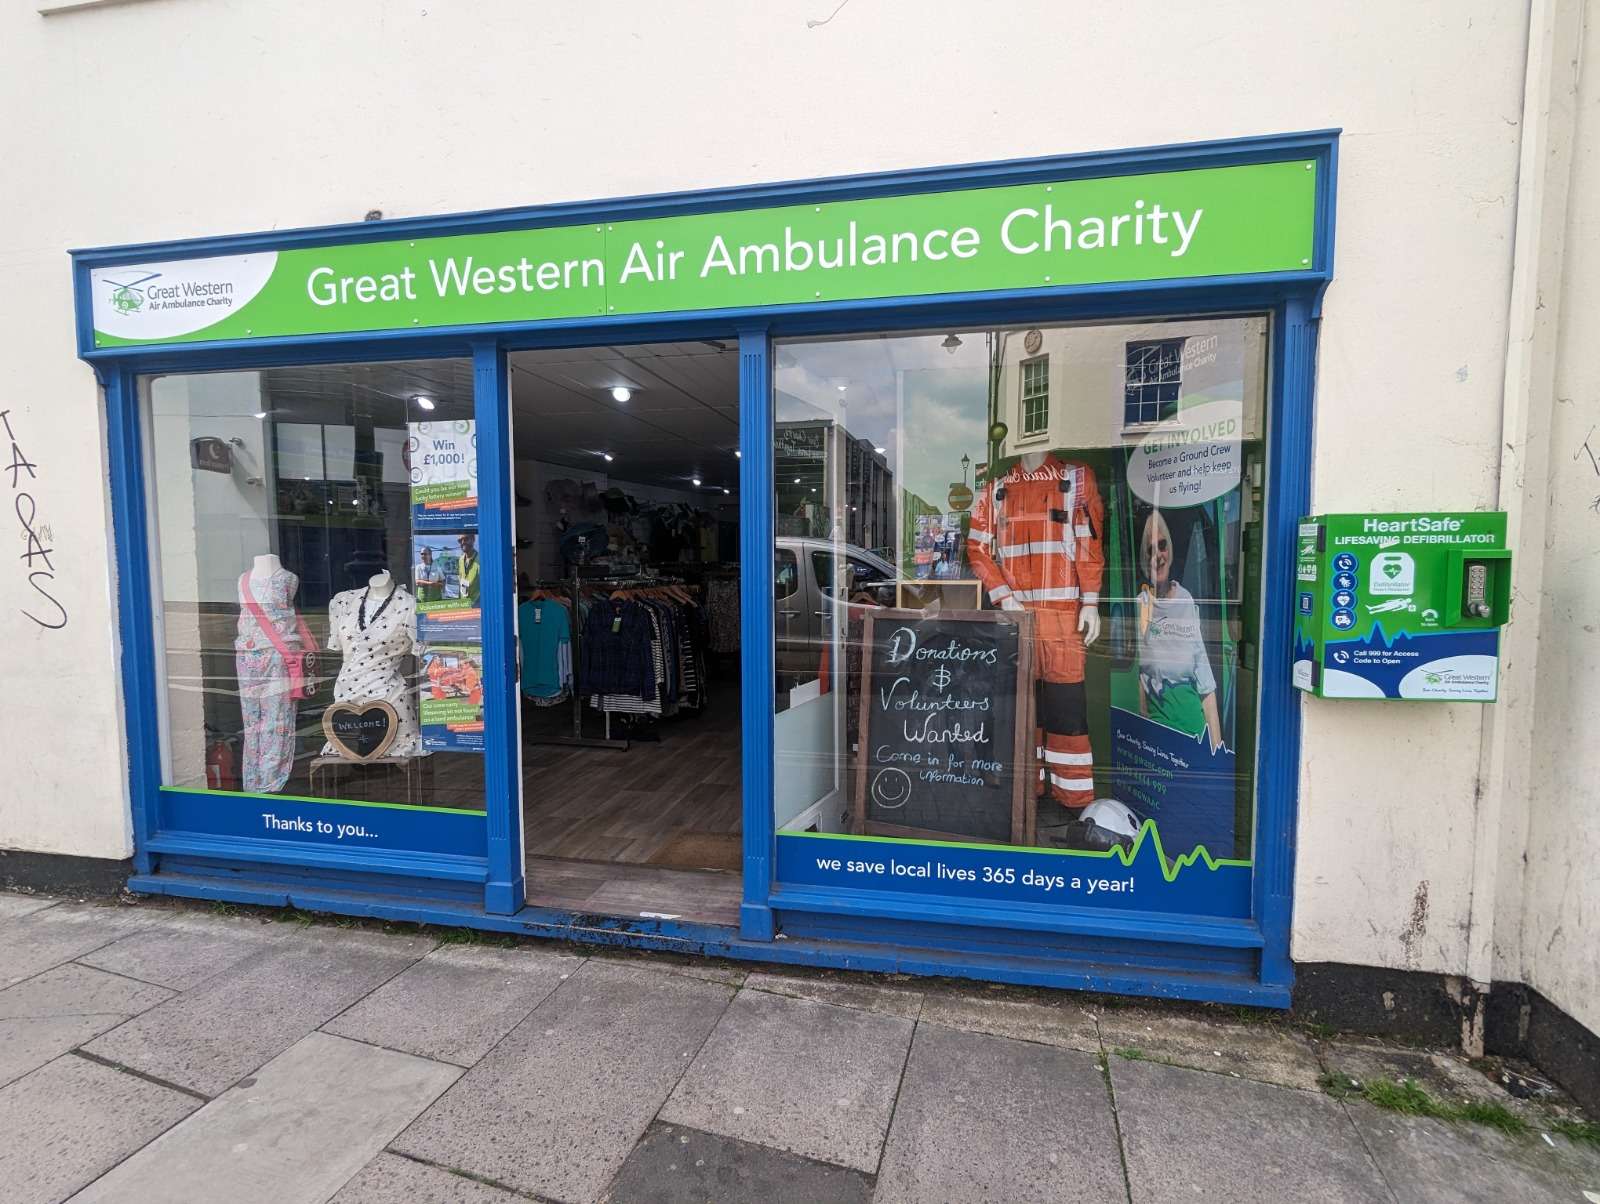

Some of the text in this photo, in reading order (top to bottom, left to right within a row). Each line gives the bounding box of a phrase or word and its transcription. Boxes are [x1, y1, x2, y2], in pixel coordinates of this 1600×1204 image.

[307, 199, 1203, 305] Great Western Air Ambulance Charity
[147, 280, 233, 300] Great Western
[149, 296, 233, 311] Air Ambulance Charity
[432, 439, 455, 451] Win
[1143, 420, 1236, 455] GET INVOLVED
[423, 453, 465, 466] £1,000!
[1148, 457, 1172, 469] Become
[1179, 446, 1209, 462] Ground
[1210, 444, 1231, 456] Crew
[1147, 460, 1232, 484] Volunteer and help keep
[1169, 479, 1202, 495] us flying!
[1334, 534, 1495, 545] LIFESAVING DEFIBRILLATOR
[886, 626, 998, 663] Donations
[1382, 657, 1400, 665] Open
[881, 676, 989, 711] Volunteers
[903, 712, 990, 744] Wanted
[876, 744, 921, 762] Come
[928, 752, 940, 766] in
[948, 755, 965, 771] for
[919, 767, 984, 786] information
[262, 814, 379, 839] Thanks to you...
[816, 858, 1135, 895] we save local lives 365 days a year!
